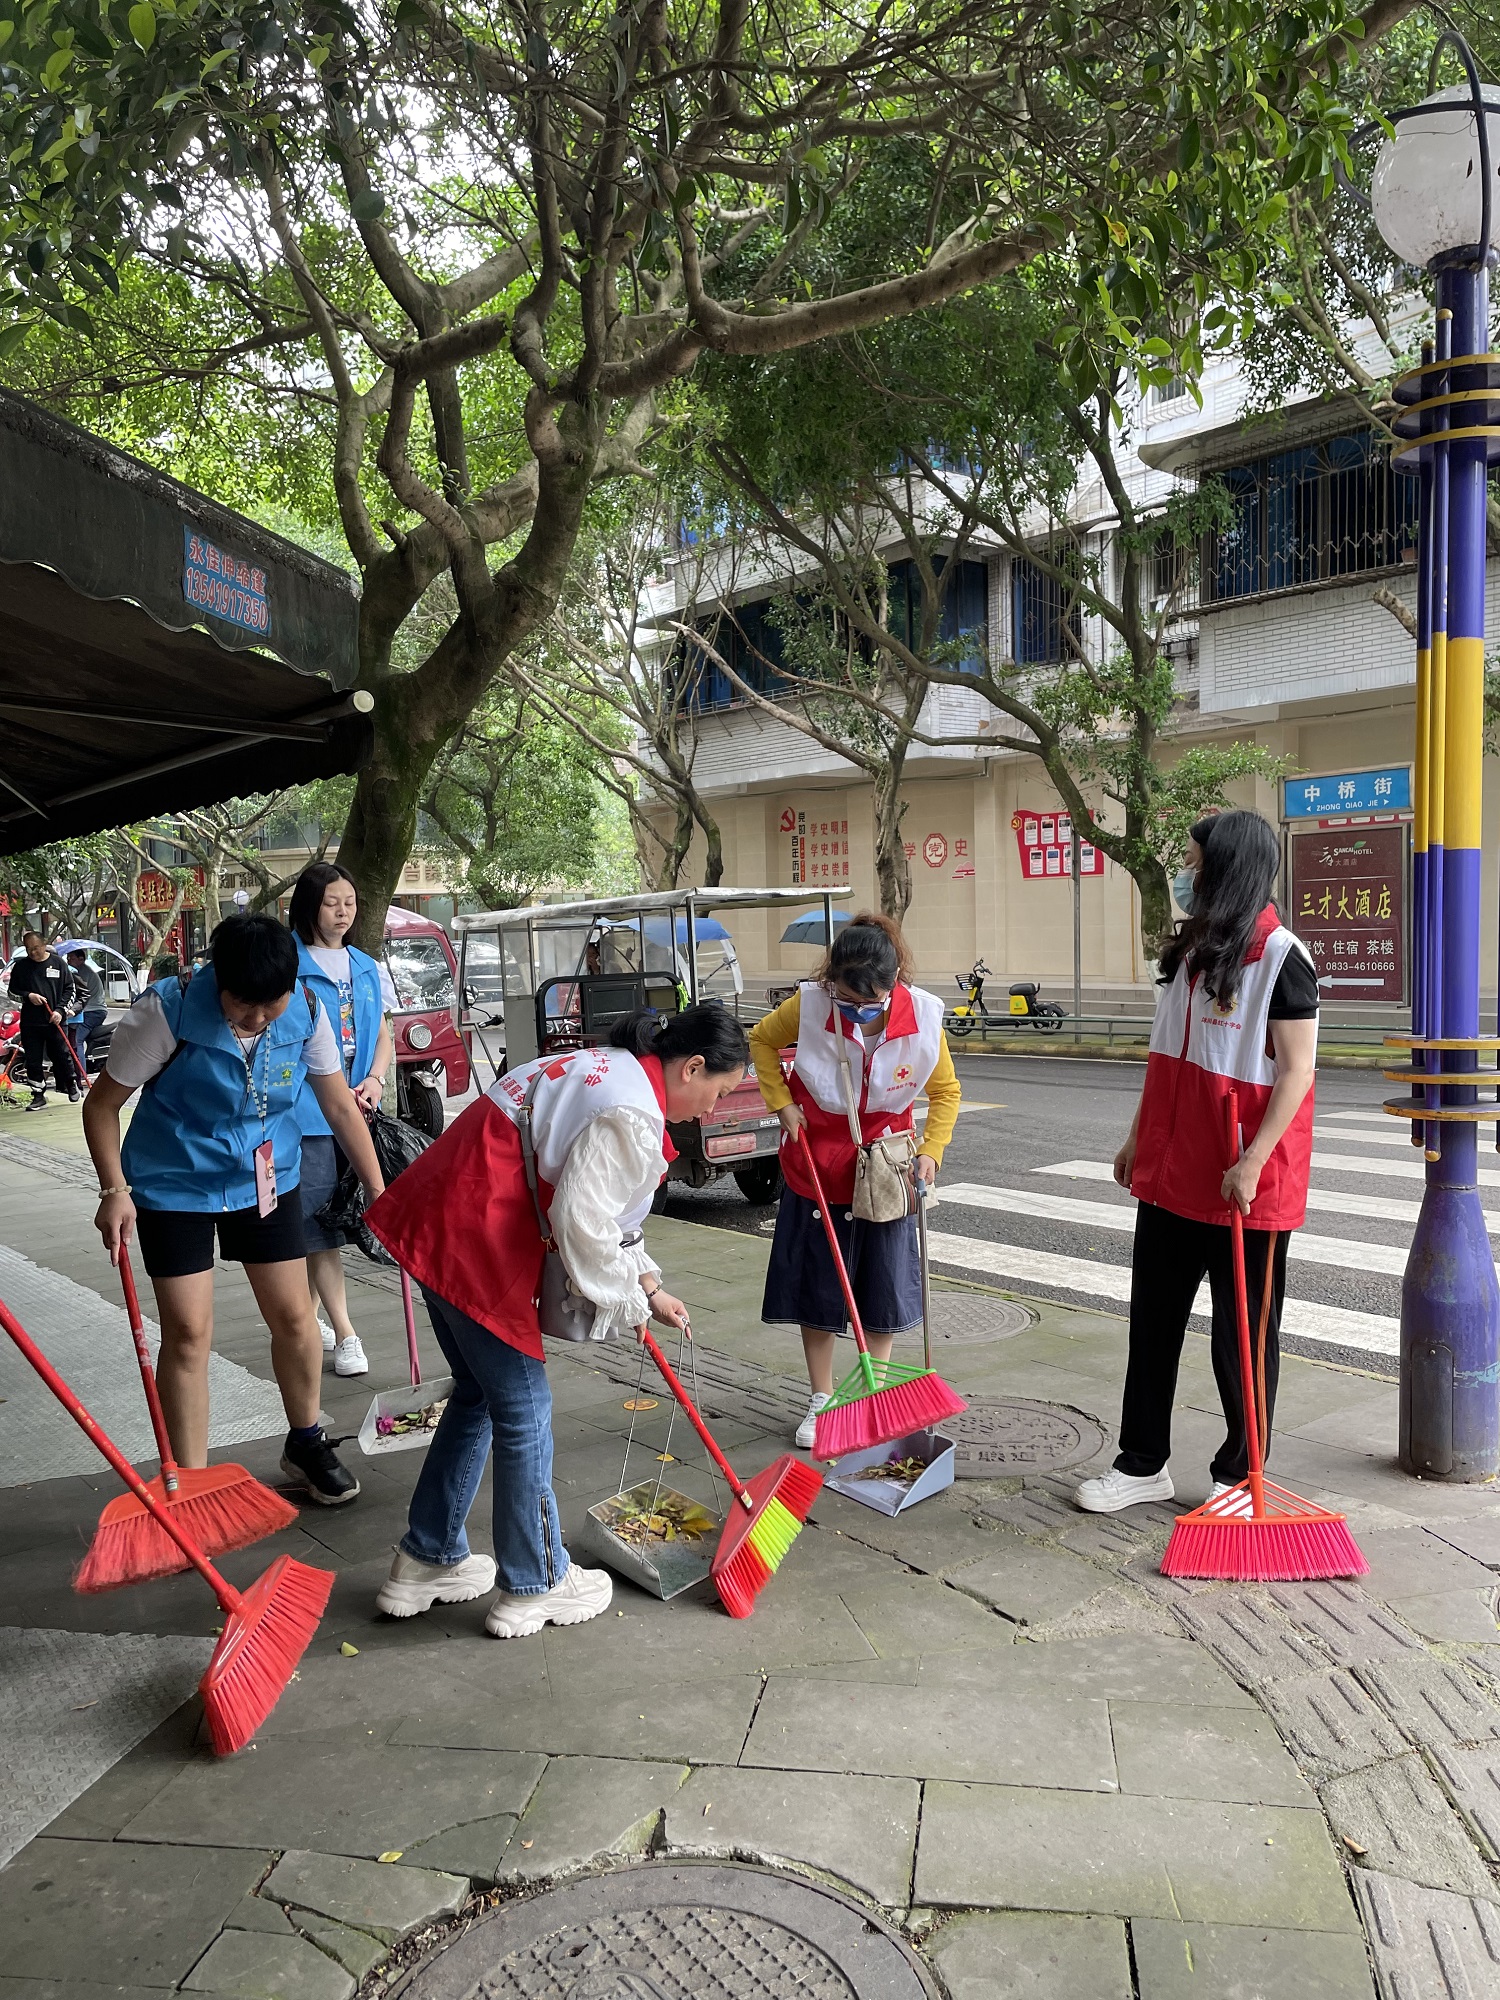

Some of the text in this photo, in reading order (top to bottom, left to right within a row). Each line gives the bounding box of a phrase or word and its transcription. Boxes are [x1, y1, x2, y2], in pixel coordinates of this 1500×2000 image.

[187, 567, 268, 630] 13541917350
[1304, 778, 1392, 802] 中桥街
[1316, 799, 1379, 812] ZHONG QIAO JIE
[810, 821, 848, 837] 学史明理
[792, 835, 800, 883] 百年历程
[810, 841, 849, 857] 学史增信
[1299, 884, 1392, 920] 三才大酒店
[1333, 940, 1359, 955] 住宿
[1366, 939, 1394, 955] 茶楼
